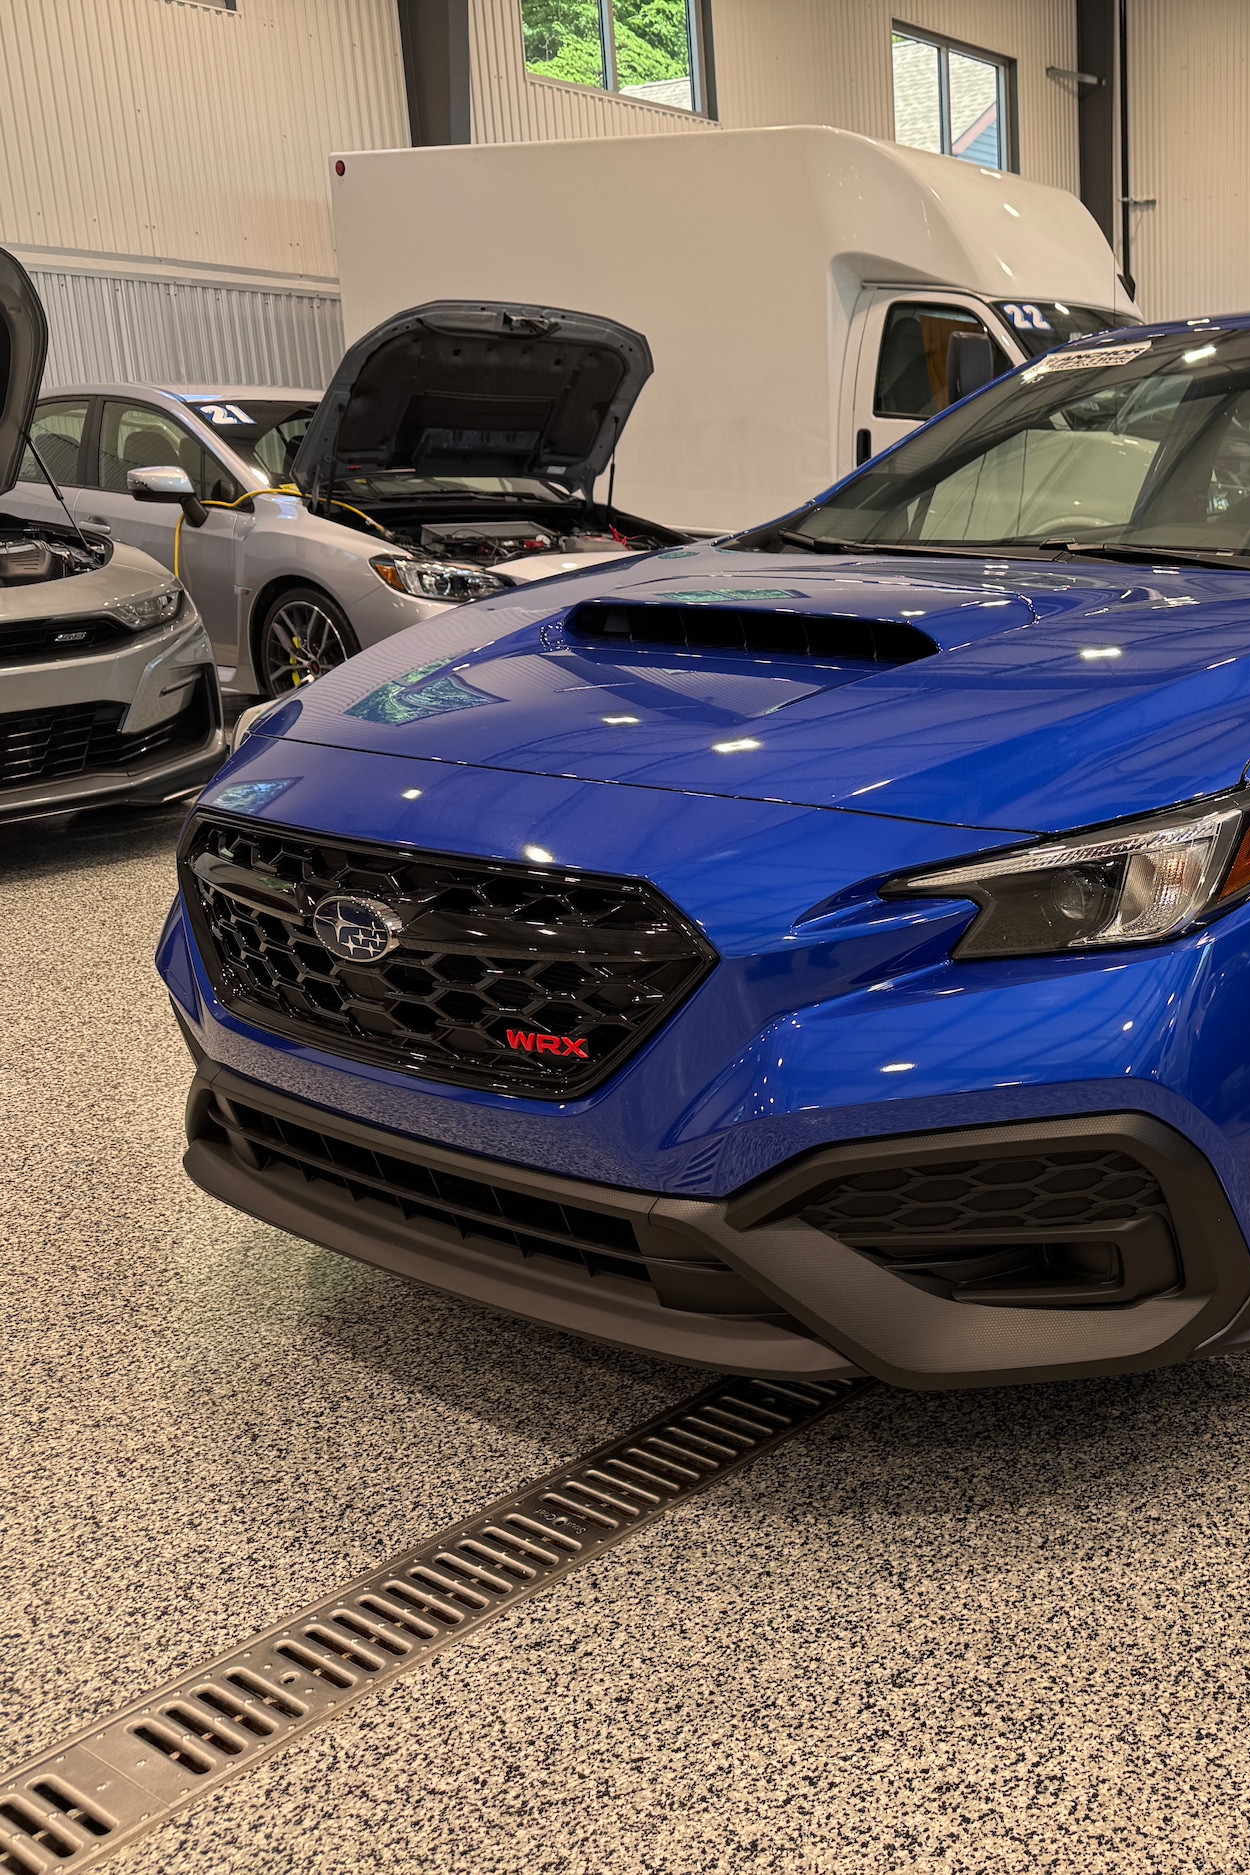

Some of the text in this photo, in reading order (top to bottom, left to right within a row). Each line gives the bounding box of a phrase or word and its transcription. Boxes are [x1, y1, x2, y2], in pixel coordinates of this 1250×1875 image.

[1003, 304, 1051, 329] 22
[200, 404, 257, 425] 21
[506, 1029, 590, 1058] WRX
